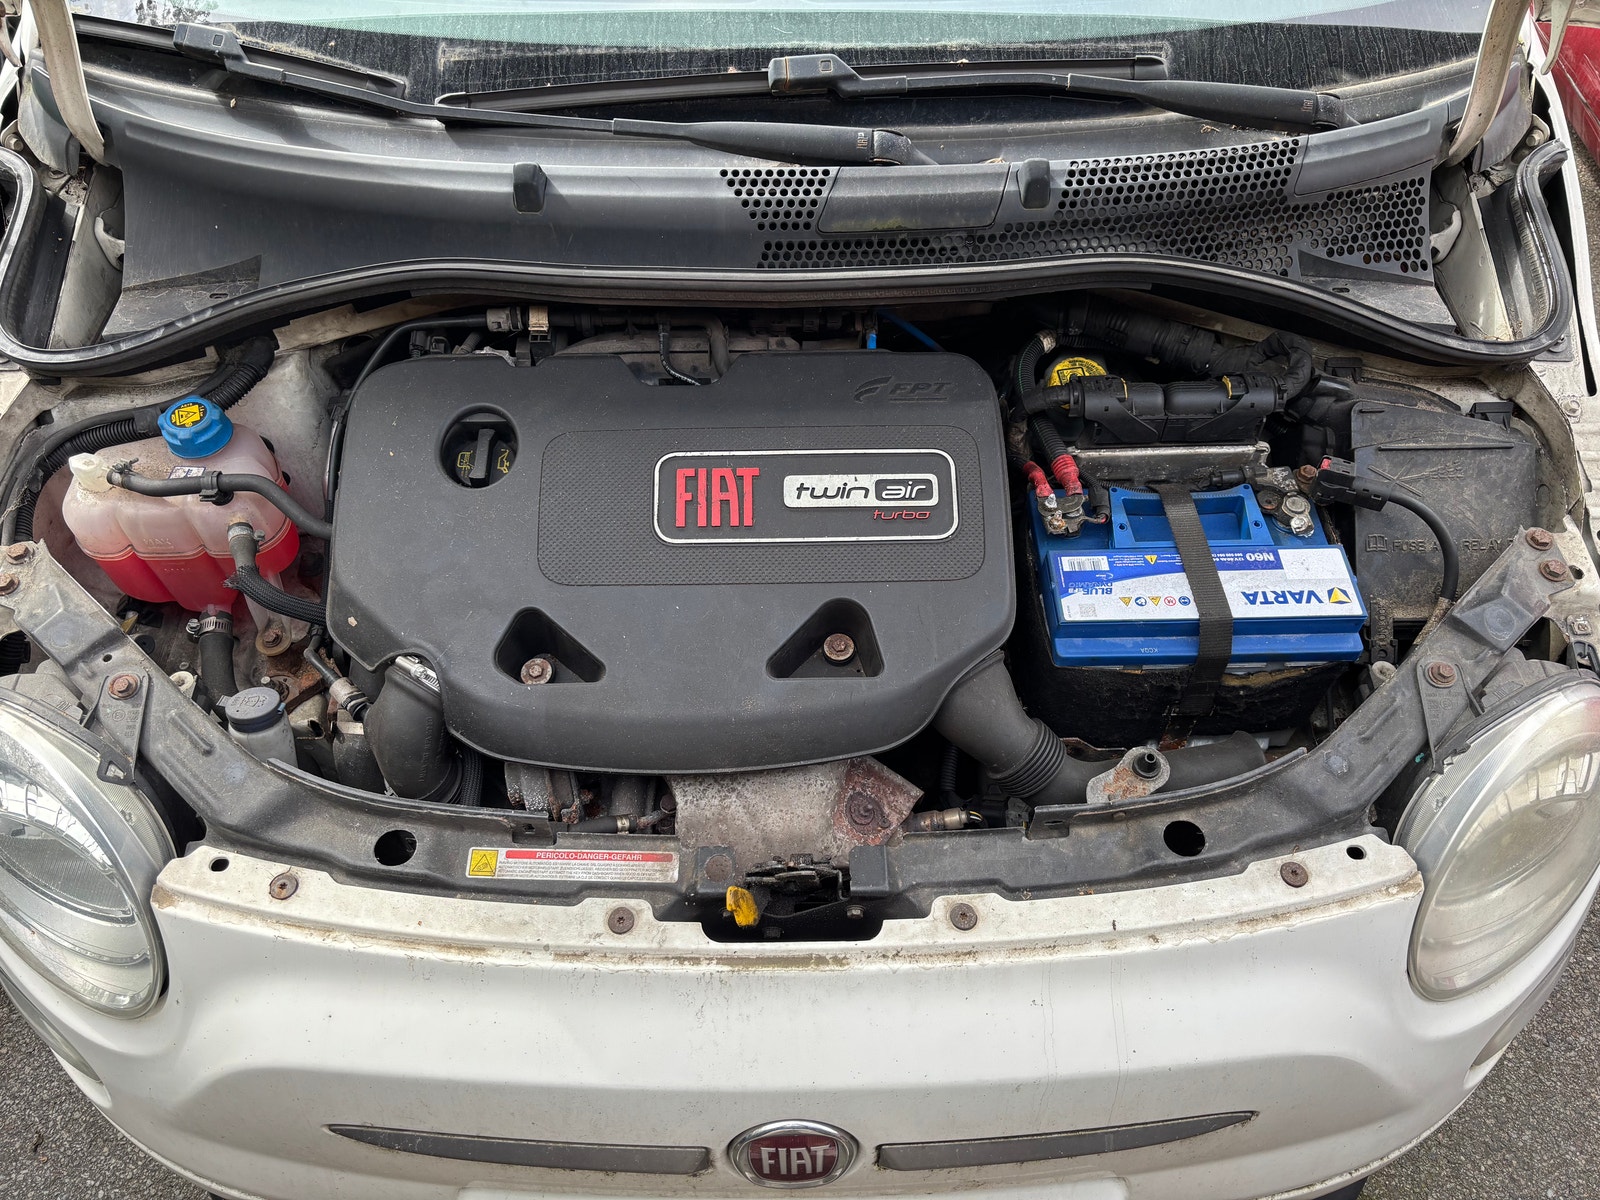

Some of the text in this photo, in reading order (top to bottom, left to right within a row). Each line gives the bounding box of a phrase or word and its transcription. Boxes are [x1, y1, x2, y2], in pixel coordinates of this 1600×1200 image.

[675, 467, 928, 528] FIAT twin air
[872, 509, 932, 520] turbo
[1392, 540, 1426, 551] FUSE
[1462, 538, 1503, 551] RELAY
[1245, 552, 1276, 562] N60
[1082, 587, 1113, 595] BLUE
[1240, 589, 1325, 606] VARTA
[536, 852, 643, 861] PERICOLO-DANGER-GEFAHR
[760, 1144, 831, 1175] FIAT
